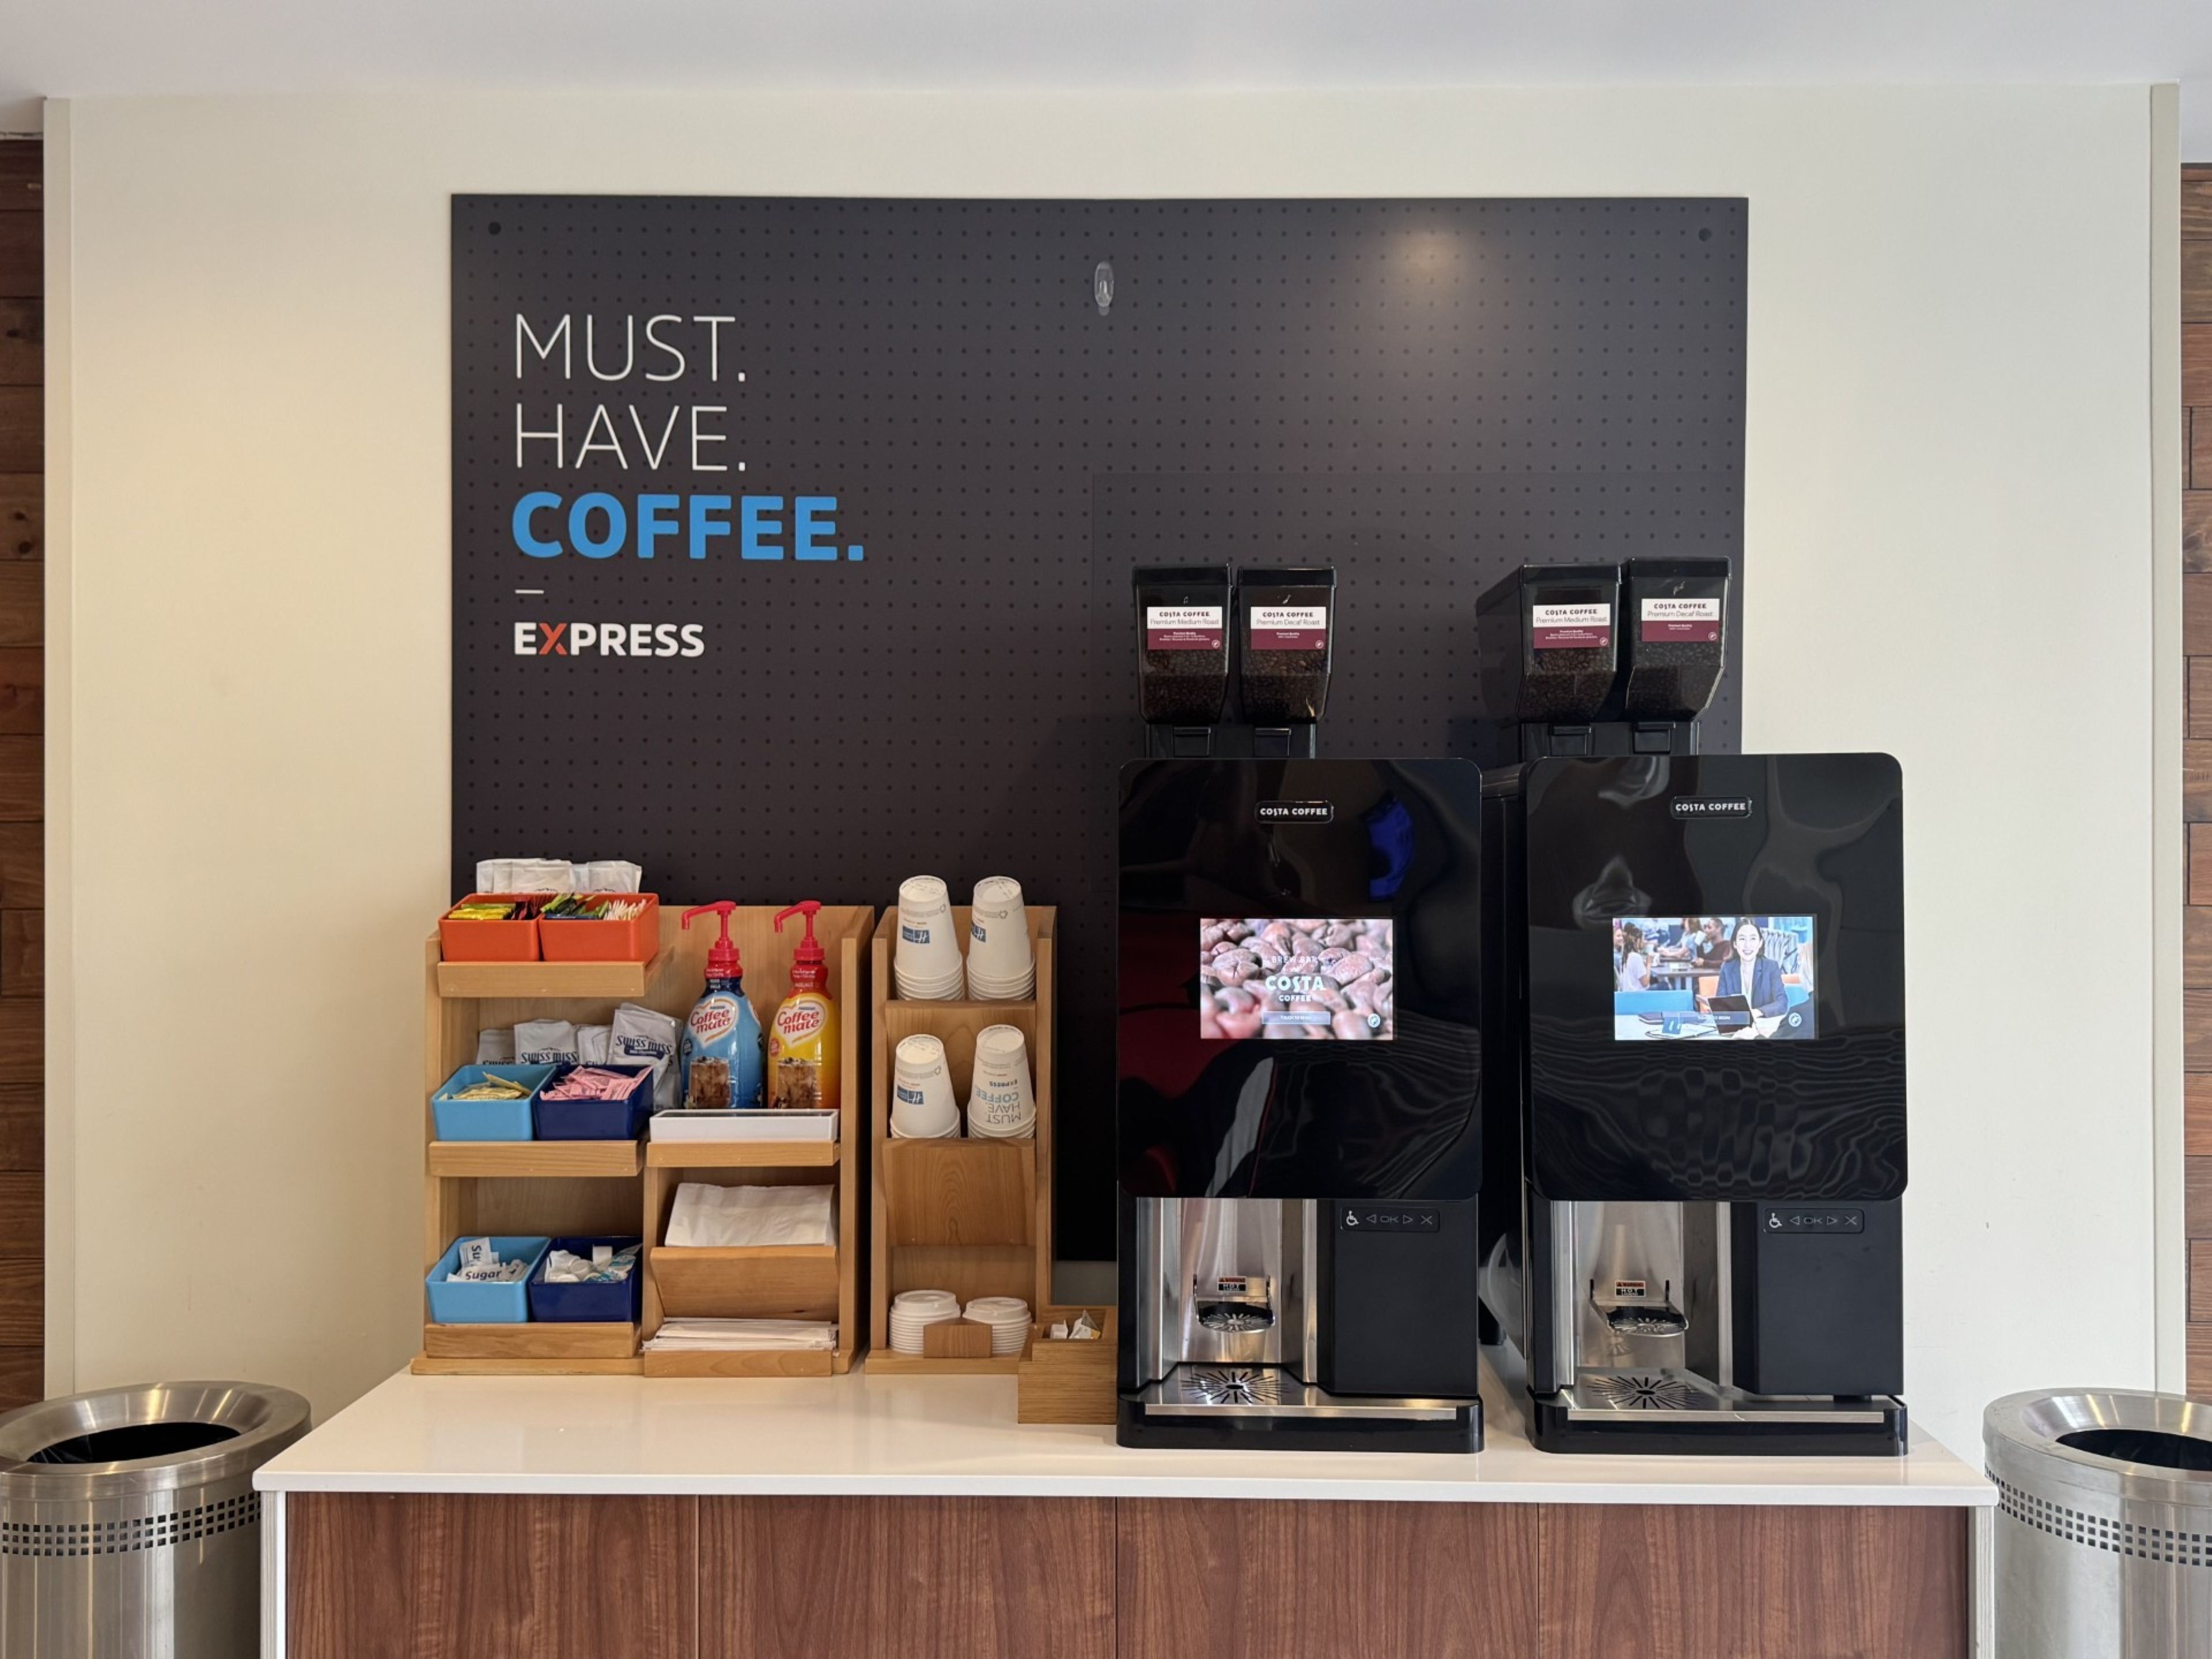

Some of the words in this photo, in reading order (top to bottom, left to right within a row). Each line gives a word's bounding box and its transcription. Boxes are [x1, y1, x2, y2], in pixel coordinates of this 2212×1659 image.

[516, 313, 745, 382] MUST.
[517, 403, 745, 471] HAVE.
[512, 491, 863, 561] COFFEE.
[514, 622, 705, 657] EXPRESS
[1260, 808, 1289, 816] COSTA
[1676, 803, 1705, 812] COSTA
[1709, 802, 1745, 810] COFFEE
[1266, 975, 1327, 993] COSTA
[691, 1010, 729, 1027] Coffee
[696, 1017, 730, 1034] mate
[778, 1010, 819, 1027] Coffee
[784, 1018, 819, 1034] mate
[465, 1271, 502, 1280] Sugar
